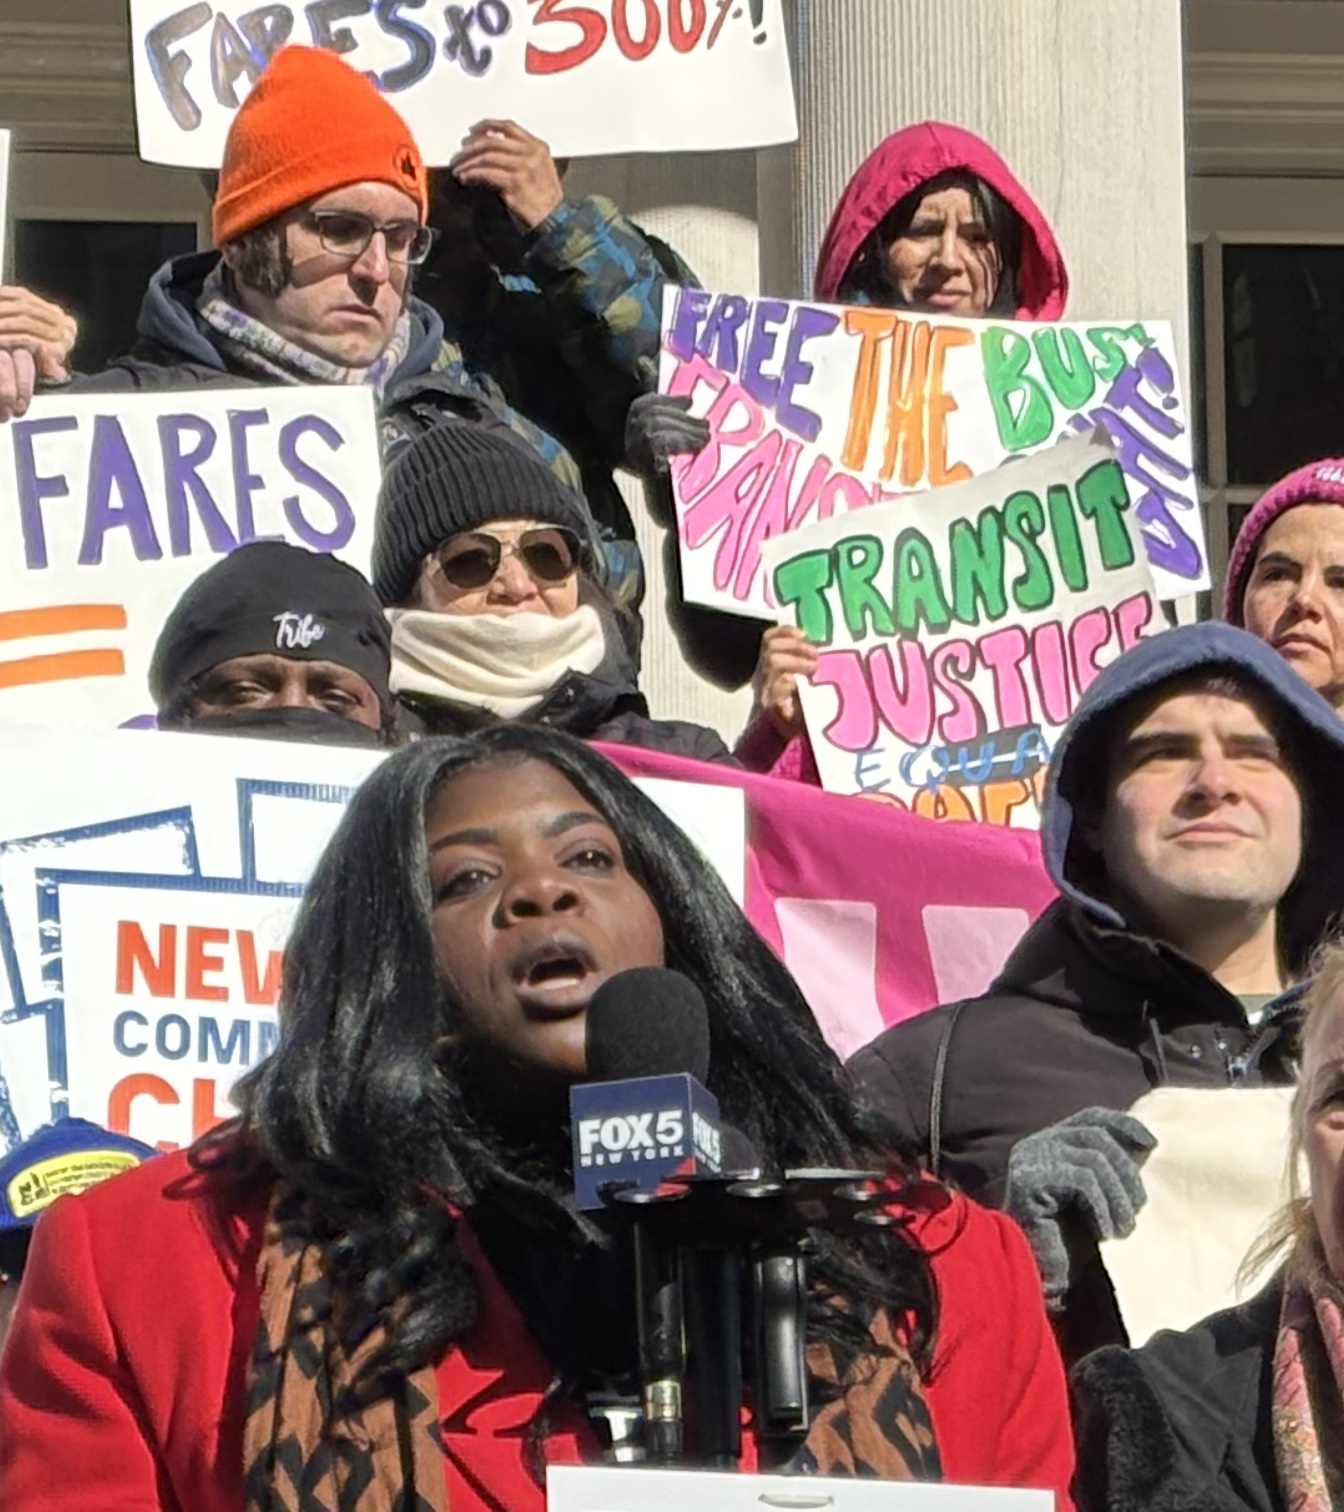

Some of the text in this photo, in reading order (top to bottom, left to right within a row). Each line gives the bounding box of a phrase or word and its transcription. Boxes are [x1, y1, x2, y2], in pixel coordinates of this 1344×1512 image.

[668, 285, 841, 443] FREE
[844, 310, 975, 487] THE
[12, 408, 357, 571] FARES
[773, 458, 1136, 645] TRANSIT
[272, 611, 325, 649] Tribe
[854, 727, 1054, 792] EQUA
[579, 1153, 623, 1168] NEW
[631, 1143, 685, 1164] YORK
